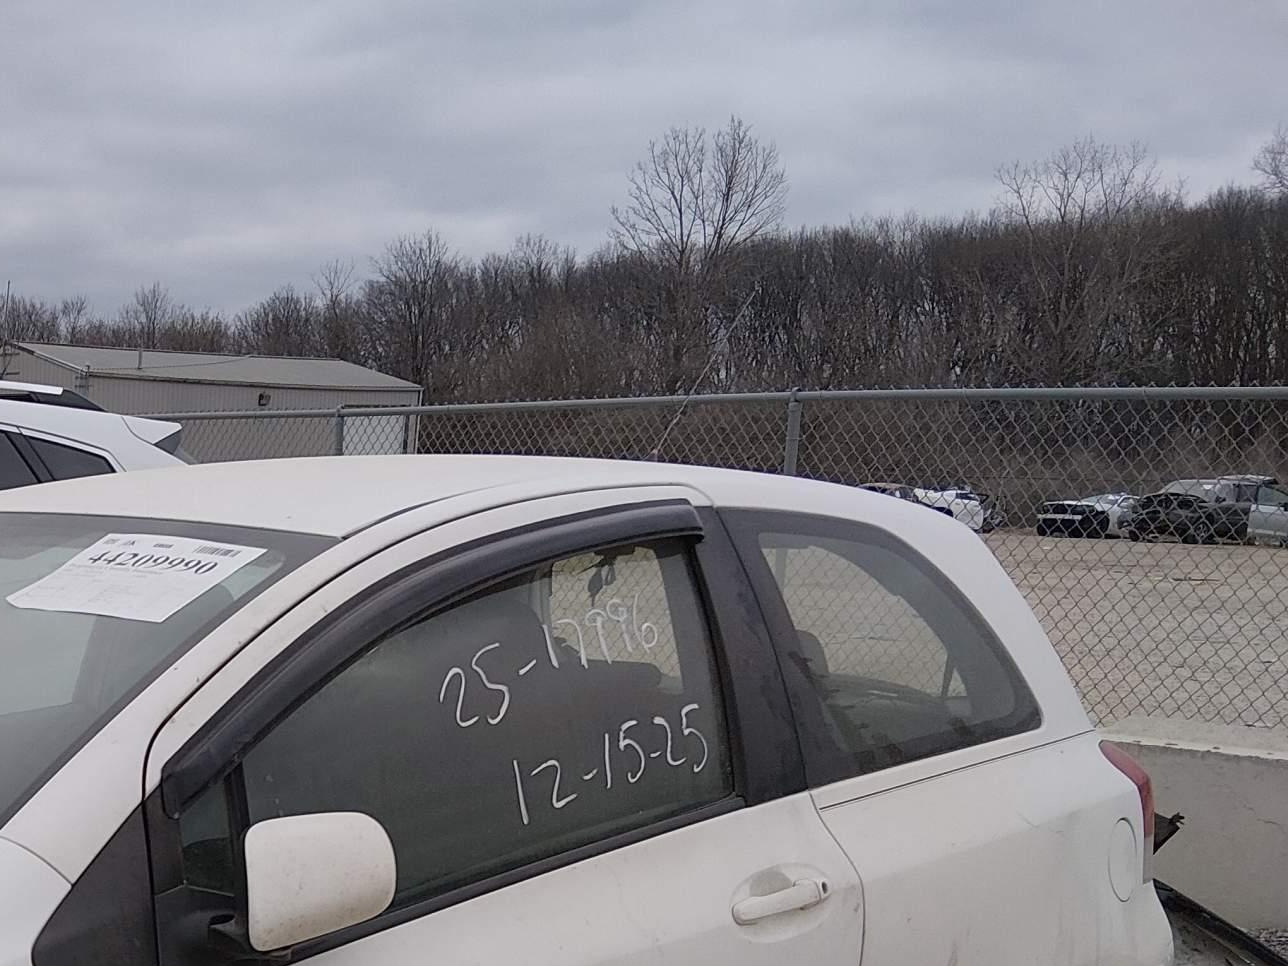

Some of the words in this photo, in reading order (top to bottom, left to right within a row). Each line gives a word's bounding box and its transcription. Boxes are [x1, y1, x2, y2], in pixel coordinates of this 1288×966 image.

[87, 549, 218, 575] 44209990
[438, 593, 659, 728] 25-17996
[512, 703, 709, 825] 12-15-25
